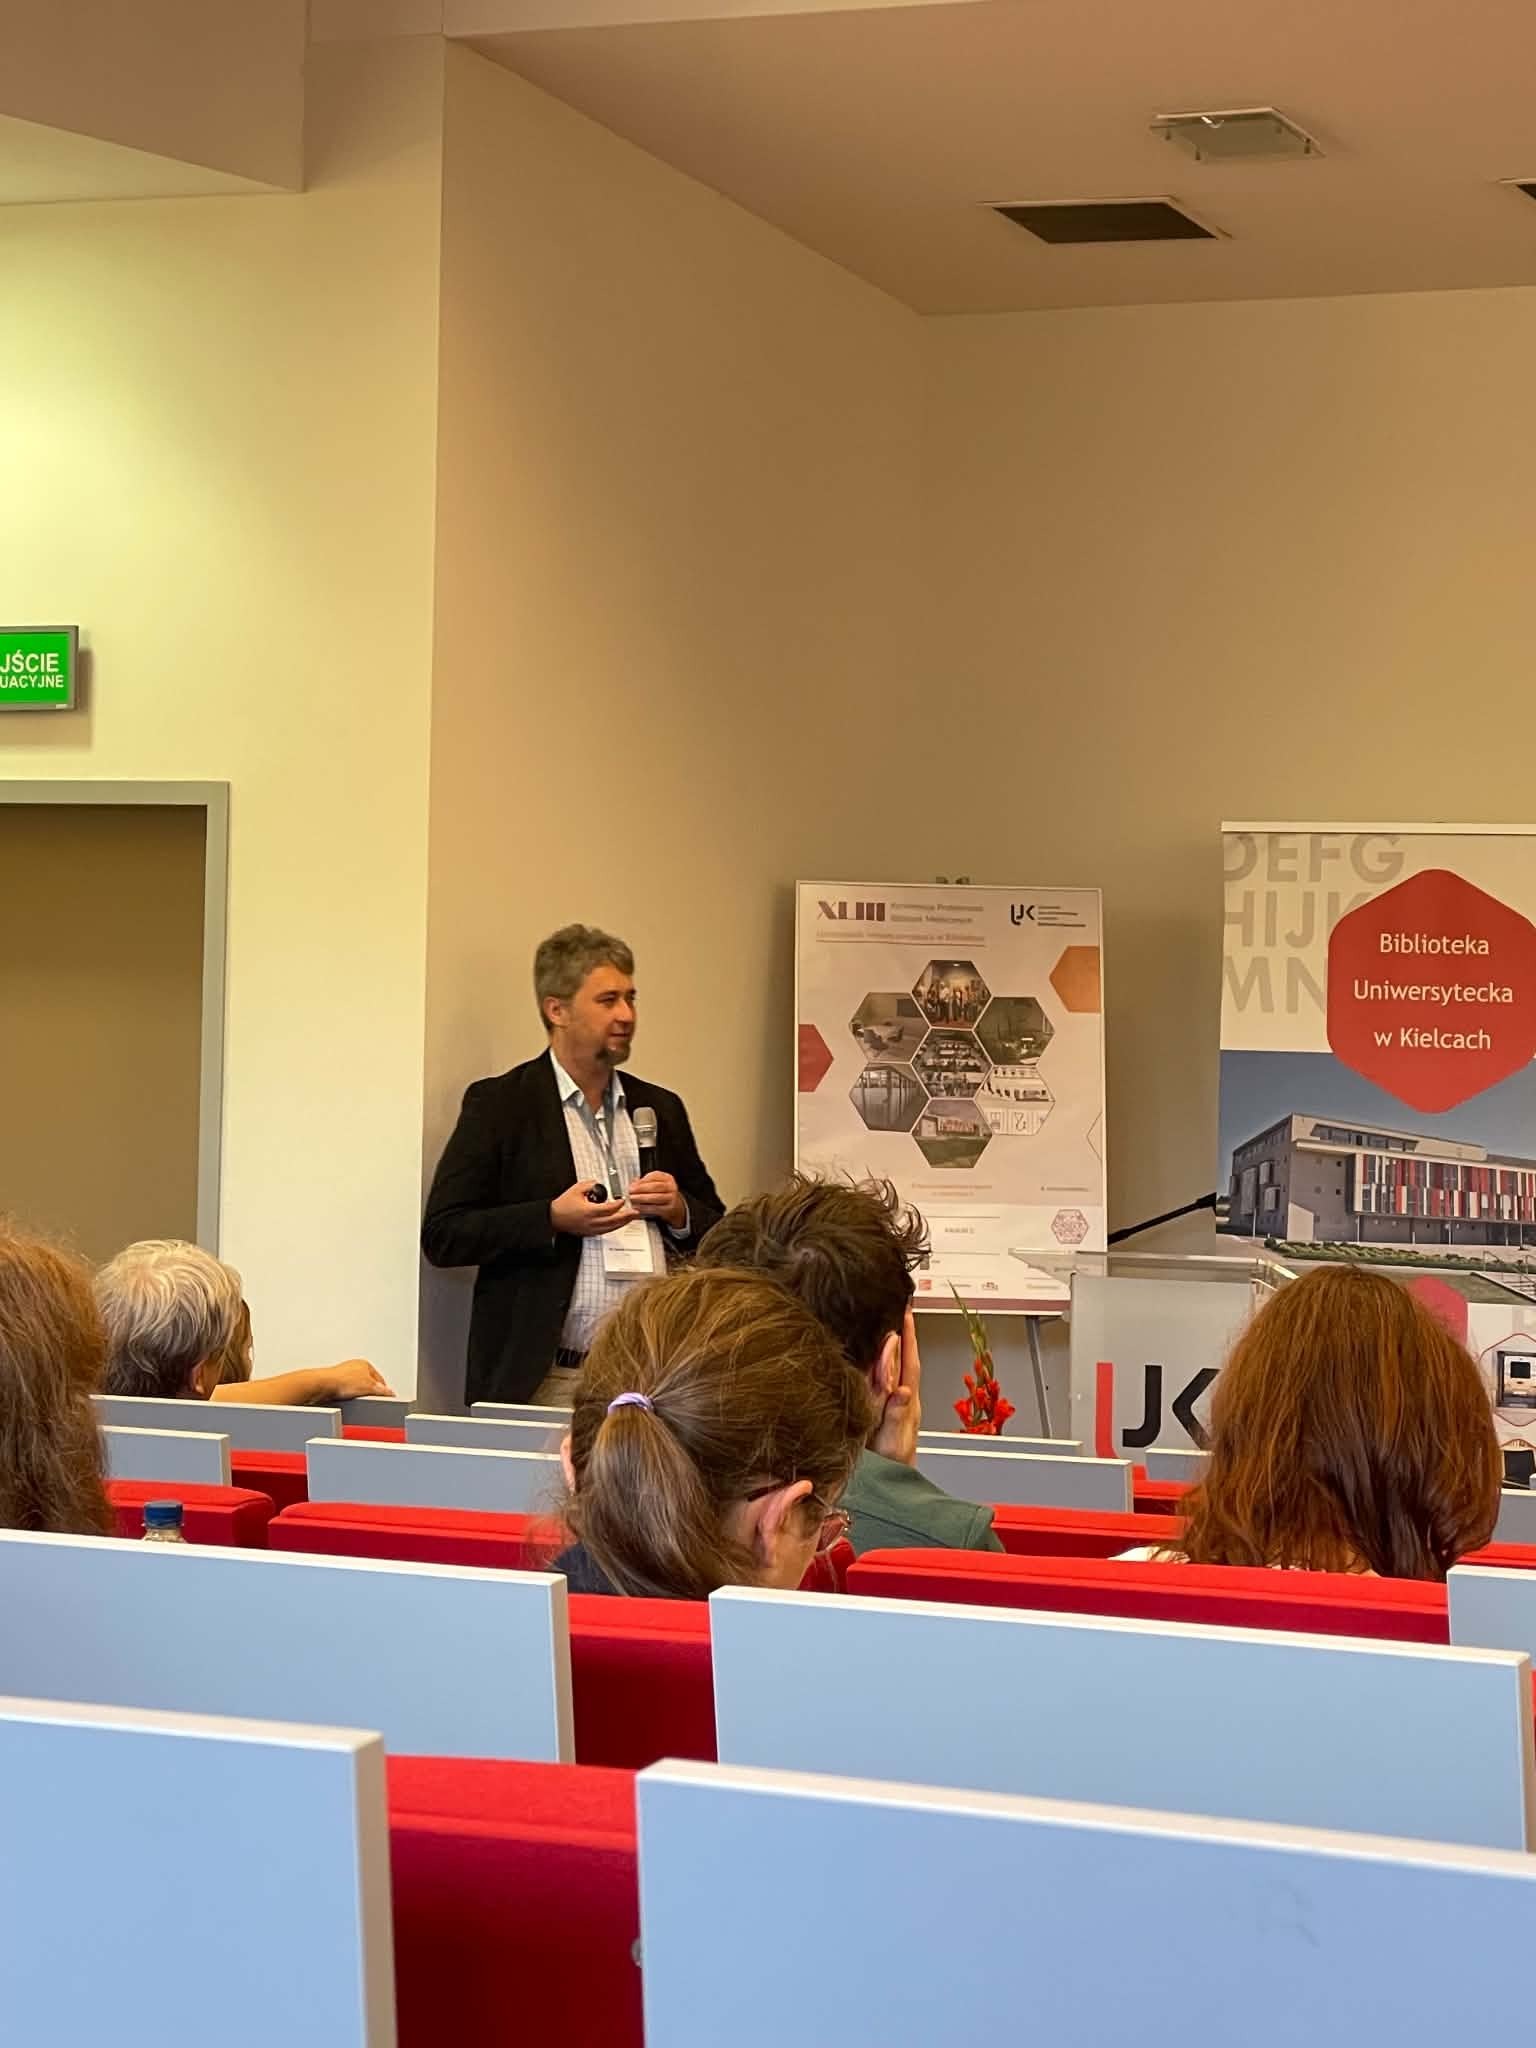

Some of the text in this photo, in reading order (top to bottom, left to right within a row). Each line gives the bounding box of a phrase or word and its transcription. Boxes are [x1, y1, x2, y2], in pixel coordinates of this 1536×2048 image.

[0, 649, 59, 673] JŚCIE
[1223, 833, 1405, 884] DEFG
[816, 900, 886, 921] XLIII
[1379, 933, 1490, 955] Biblioteka
[1353, 979, 1514, 1007] Uniwersytecka
[1374, 1028, 1491, 1050] w Kielcach
